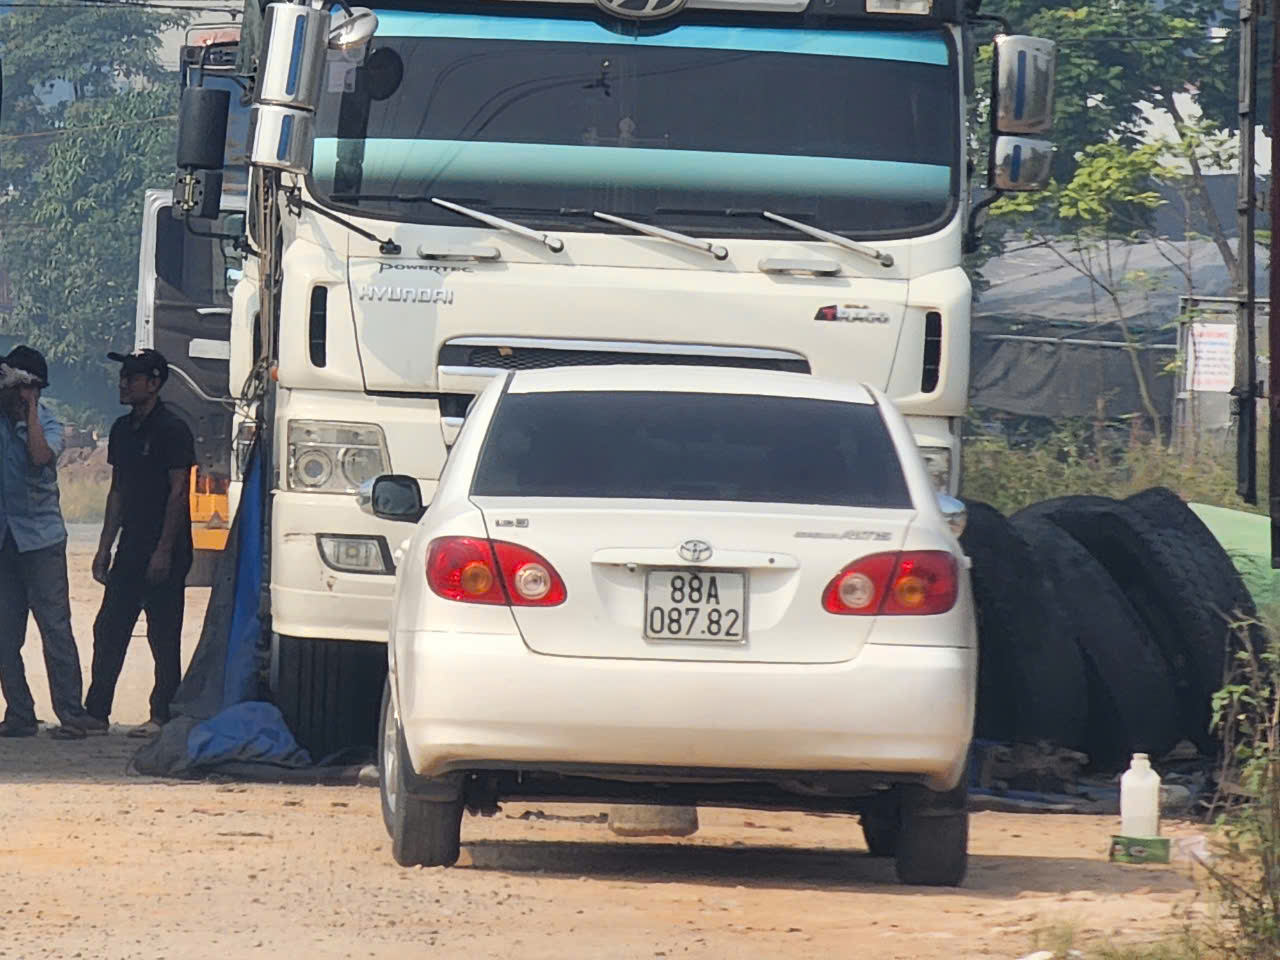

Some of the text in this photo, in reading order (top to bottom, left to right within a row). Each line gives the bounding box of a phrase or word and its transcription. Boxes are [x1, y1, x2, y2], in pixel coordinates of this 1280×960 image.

[359, 284, 455, 305] HYUNDAI
[670, 575, 720, 605] 88A
[649, 606, 740, 637] 087.82
